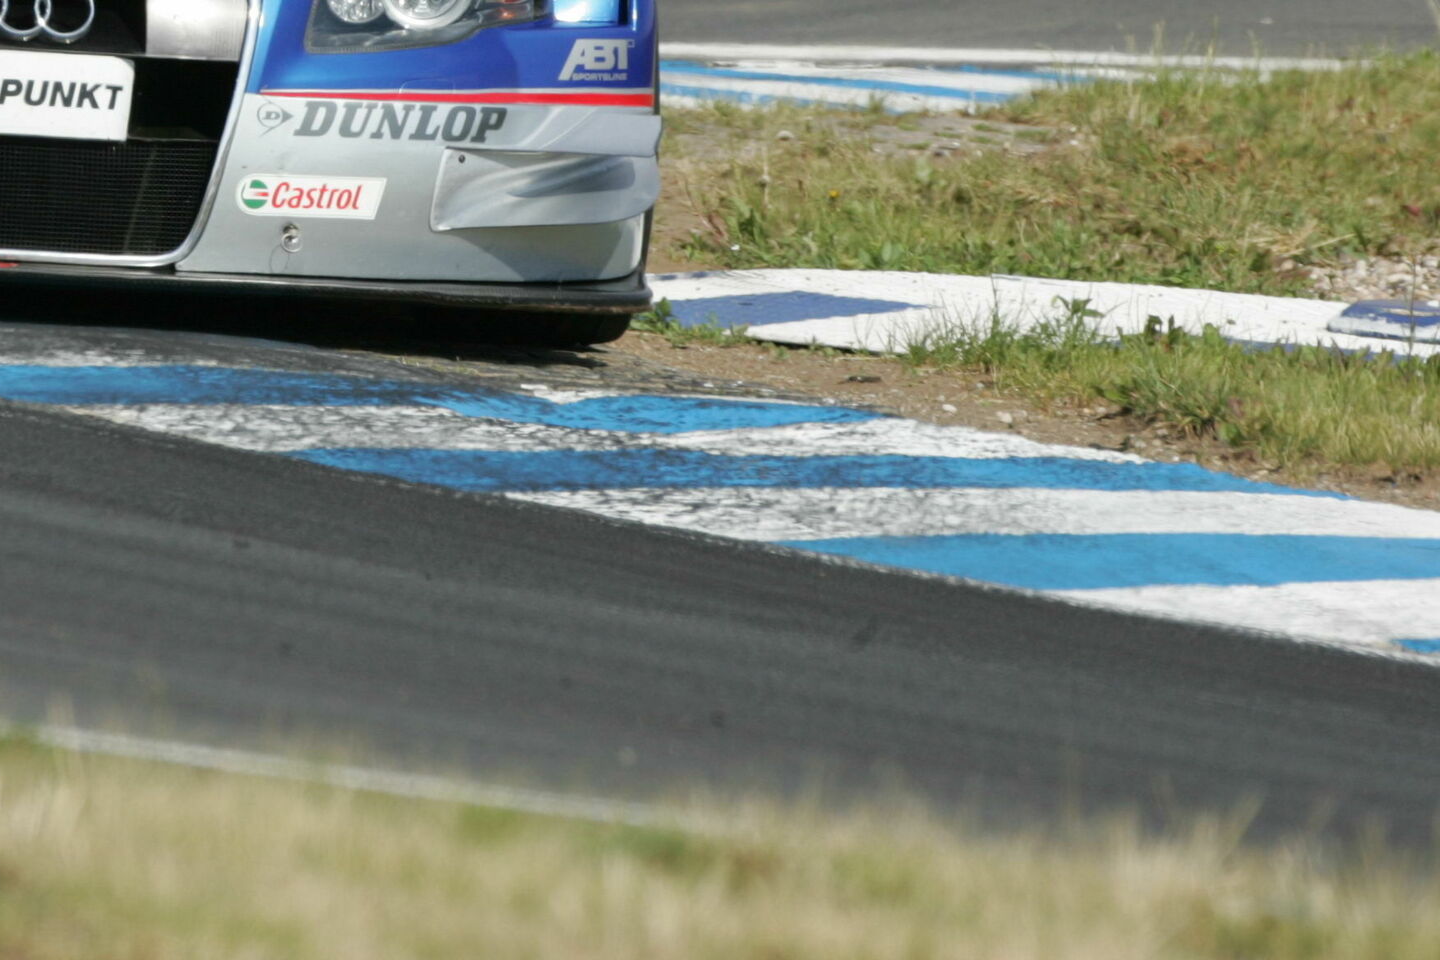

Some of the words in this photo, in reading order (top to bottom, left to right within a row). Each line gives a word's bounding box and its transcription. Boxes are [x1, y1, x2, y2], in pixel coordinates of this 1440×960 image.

[558, 38, 629, 81] ABT
[293, 100, 508, 143] DUNLOP
[271, 181, 363, 210] Castrol
